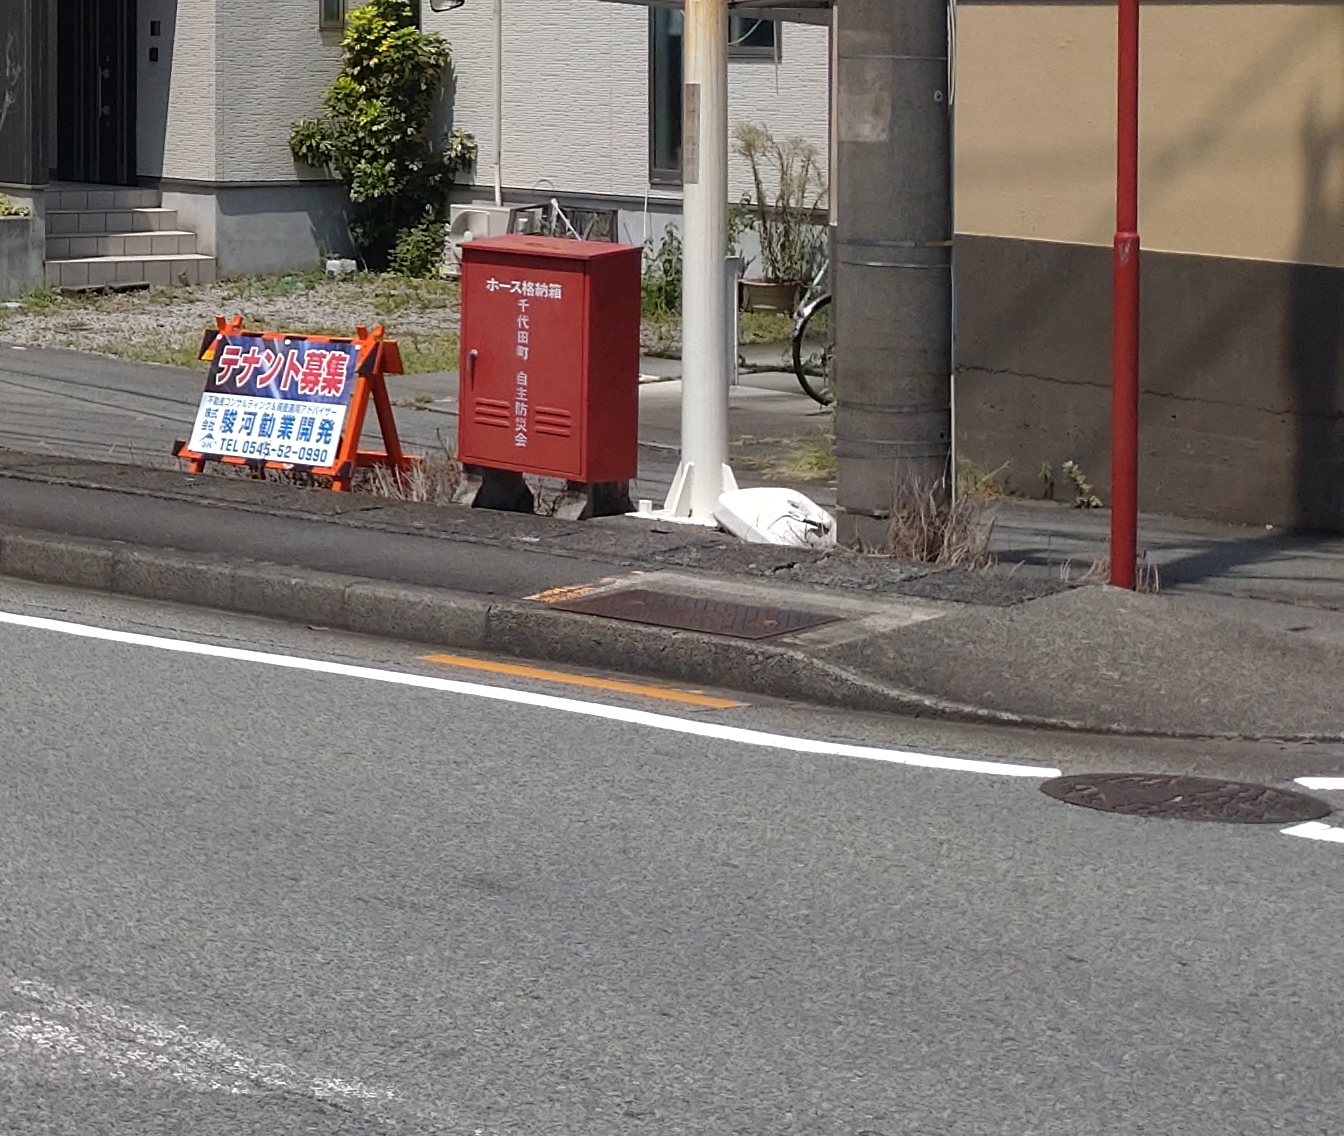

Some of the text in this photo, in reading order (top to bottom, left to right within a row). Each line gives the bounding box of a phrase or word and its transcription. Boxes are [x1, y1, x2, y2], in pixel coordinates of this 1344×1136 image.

[485, 277, 562, 300] ホース格納箱
[516, 298, 530, 360] 千代田町
[215, 345, 350, 397] テナント募集
[219, 408, 336, 445] 駿河勧業開発
[514, 371, 528, 447] 自主防災会
[219, 437, 328, 463] TEL 0545-52-0990
